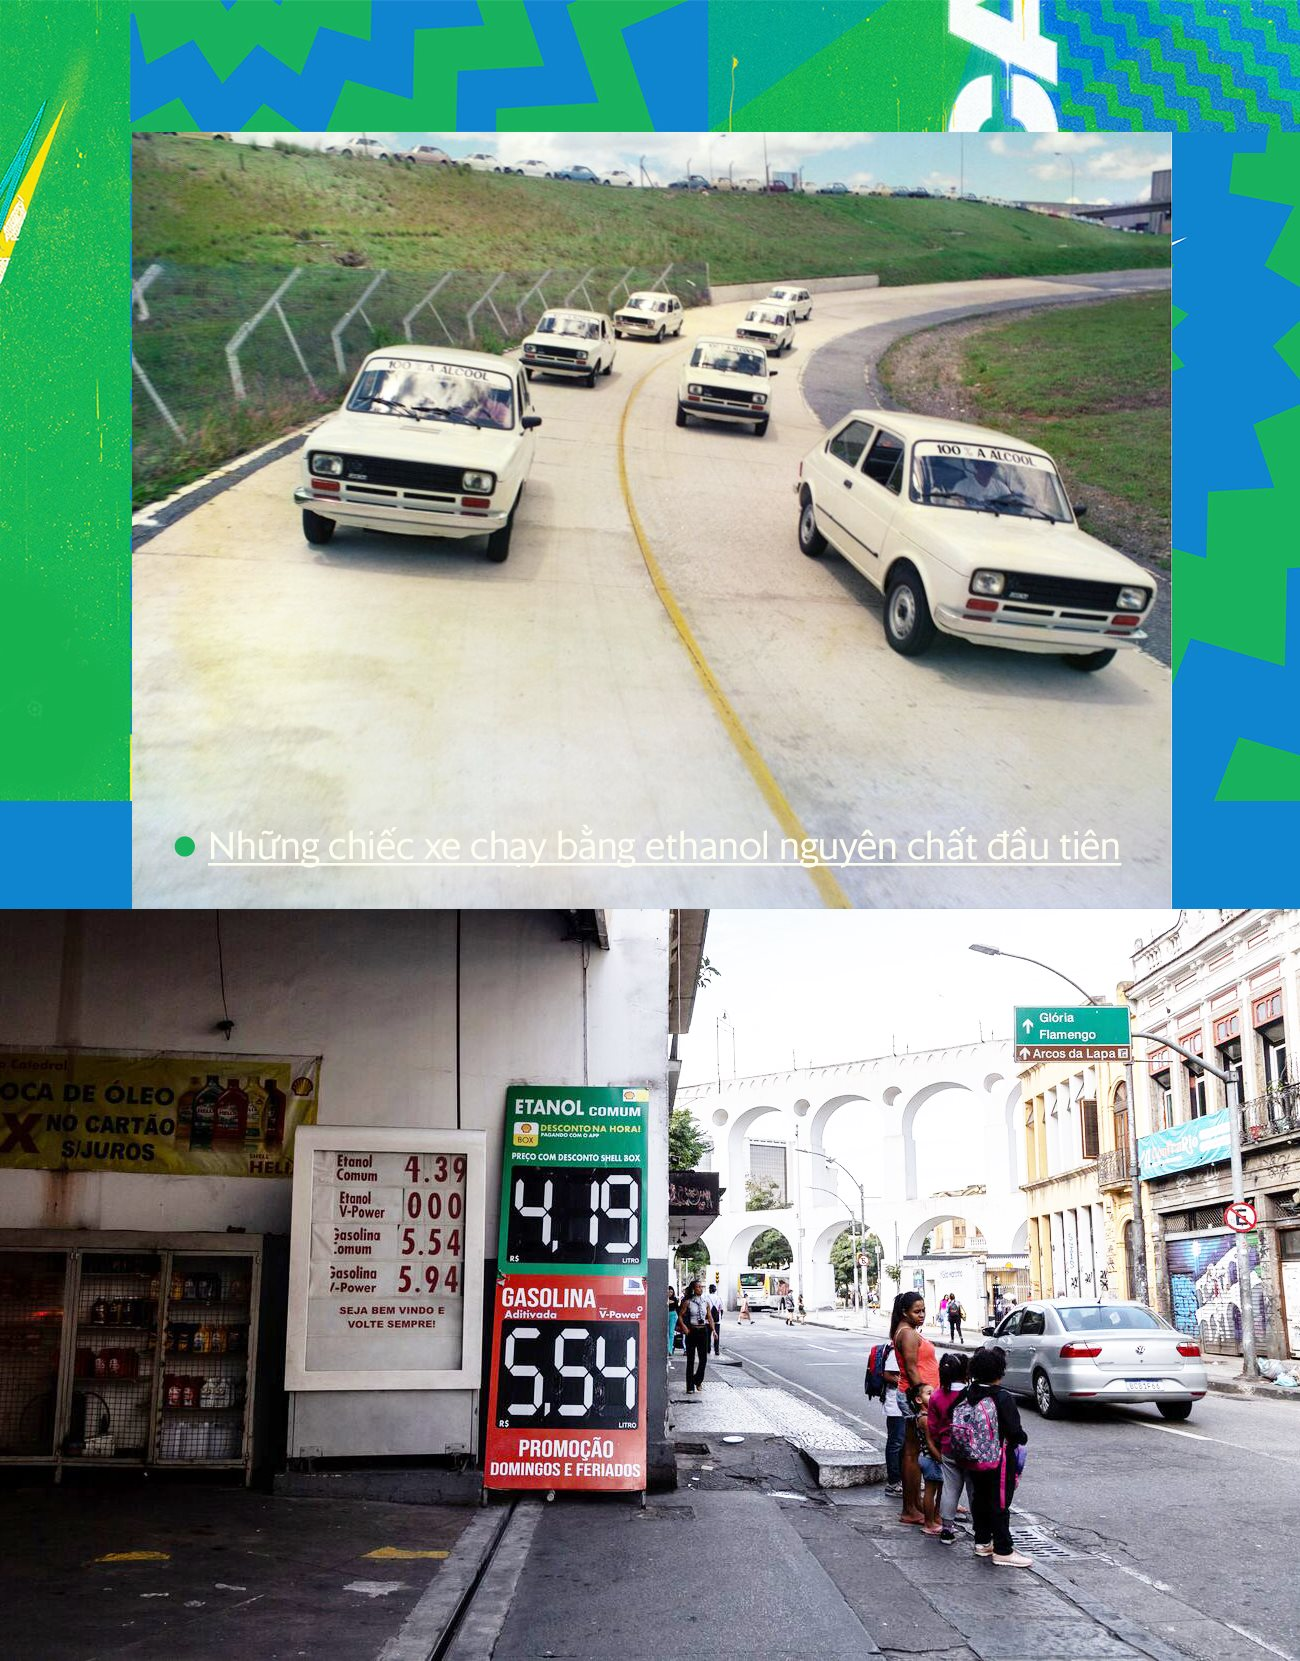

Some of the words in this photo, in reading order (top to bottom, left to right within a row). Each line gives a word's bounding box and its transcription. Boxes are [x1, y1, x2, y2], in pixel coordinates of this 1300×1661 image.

[428, 364, 435, 372] A
[441, 365, 488, 381] ALCOOL
[937, 444, 961, 455] 100
[977, 448, 986, 458] A
[990, 450, 1035, 465] ALCOOL
[1039, 1012, 1074, 1023] Glória
[1039, 1029, 1097, 1042] Flamengo
[1033, 1048, 1066, 1059] Arcos
[1068, 1048, 1083, 1059] da
[1086, 1049, 1116, 1061] Lapa
[0, 1082, 54, 1102] OCA
[64, 1083, 96, 1102] DE
[104, 1080, 175, 1106] ÓLEO
[514, 1098, 584, 1116] ETANOL
[588, 1106, 641, 1117] COMUM
[46, 1114, 78, 1132] NO
[85, 1113, 175, 1136] CARTÃO
[540, 1124, 592, 1134] DESCONTO
[593, 1125, 607, 1134] NA
[609, 1125, 641, 1134] HORA!
[0, 1113, 43, 1153] X
[517, 1136, 534, 1144] BOX
[61, 1140, 155, 1161] S/JUROS
[511, 1152, 536, 1162] PREÇO
[538, 1153, 556, 1161] COM
[557, 1153, 599, 1162] DESCONTO
[600, 1154, 622, 1162] SHELL
[623, 1154, 640, 1162] BOX
[250, 1160, 293, 1175] HELI
[337, 1154, 373, 1168] Etanol
[405, 1156, 467, 1182] 4.39
[336, 1169, 378, 1182] Comum
[340, 1191, 371, 1205] Etanol
[340, 1205, 385, 1219] V-Power
[334, 1241, 372, 1255] omum
[402, 1228, 461, 1256] 5.54
[509, 1254, 520, 1263] R$
[398, 1265, 459, 1293] 5.94
[501, 1287, 597, 1308] GASOLINA
[339, 1306, 368, 1316] SEJA
[371, 1306, 396, 1315] BEM
[399, 1306, 435, 1315] VINDO
[438, 1306, 445, 1315] E
[504, 1310, 557, 1319] Aditivada
[599, 1310, 641, 1319] V-Power
[347, 1320, 384, 1329] VOLTE
[387, 1320, 436, 1329] SEMPRE!
[499, 1418, 510, 1428] R$
[618, 1421, 637, 1429] LITRO
[518, 1437, 614, 1461] PROMOÇÃO
[490, 1461, 561, 1476] DOMINGOS
[565, 1463, 572, 1476] E
[576, 1463, 641, 1478] FERIADOS
